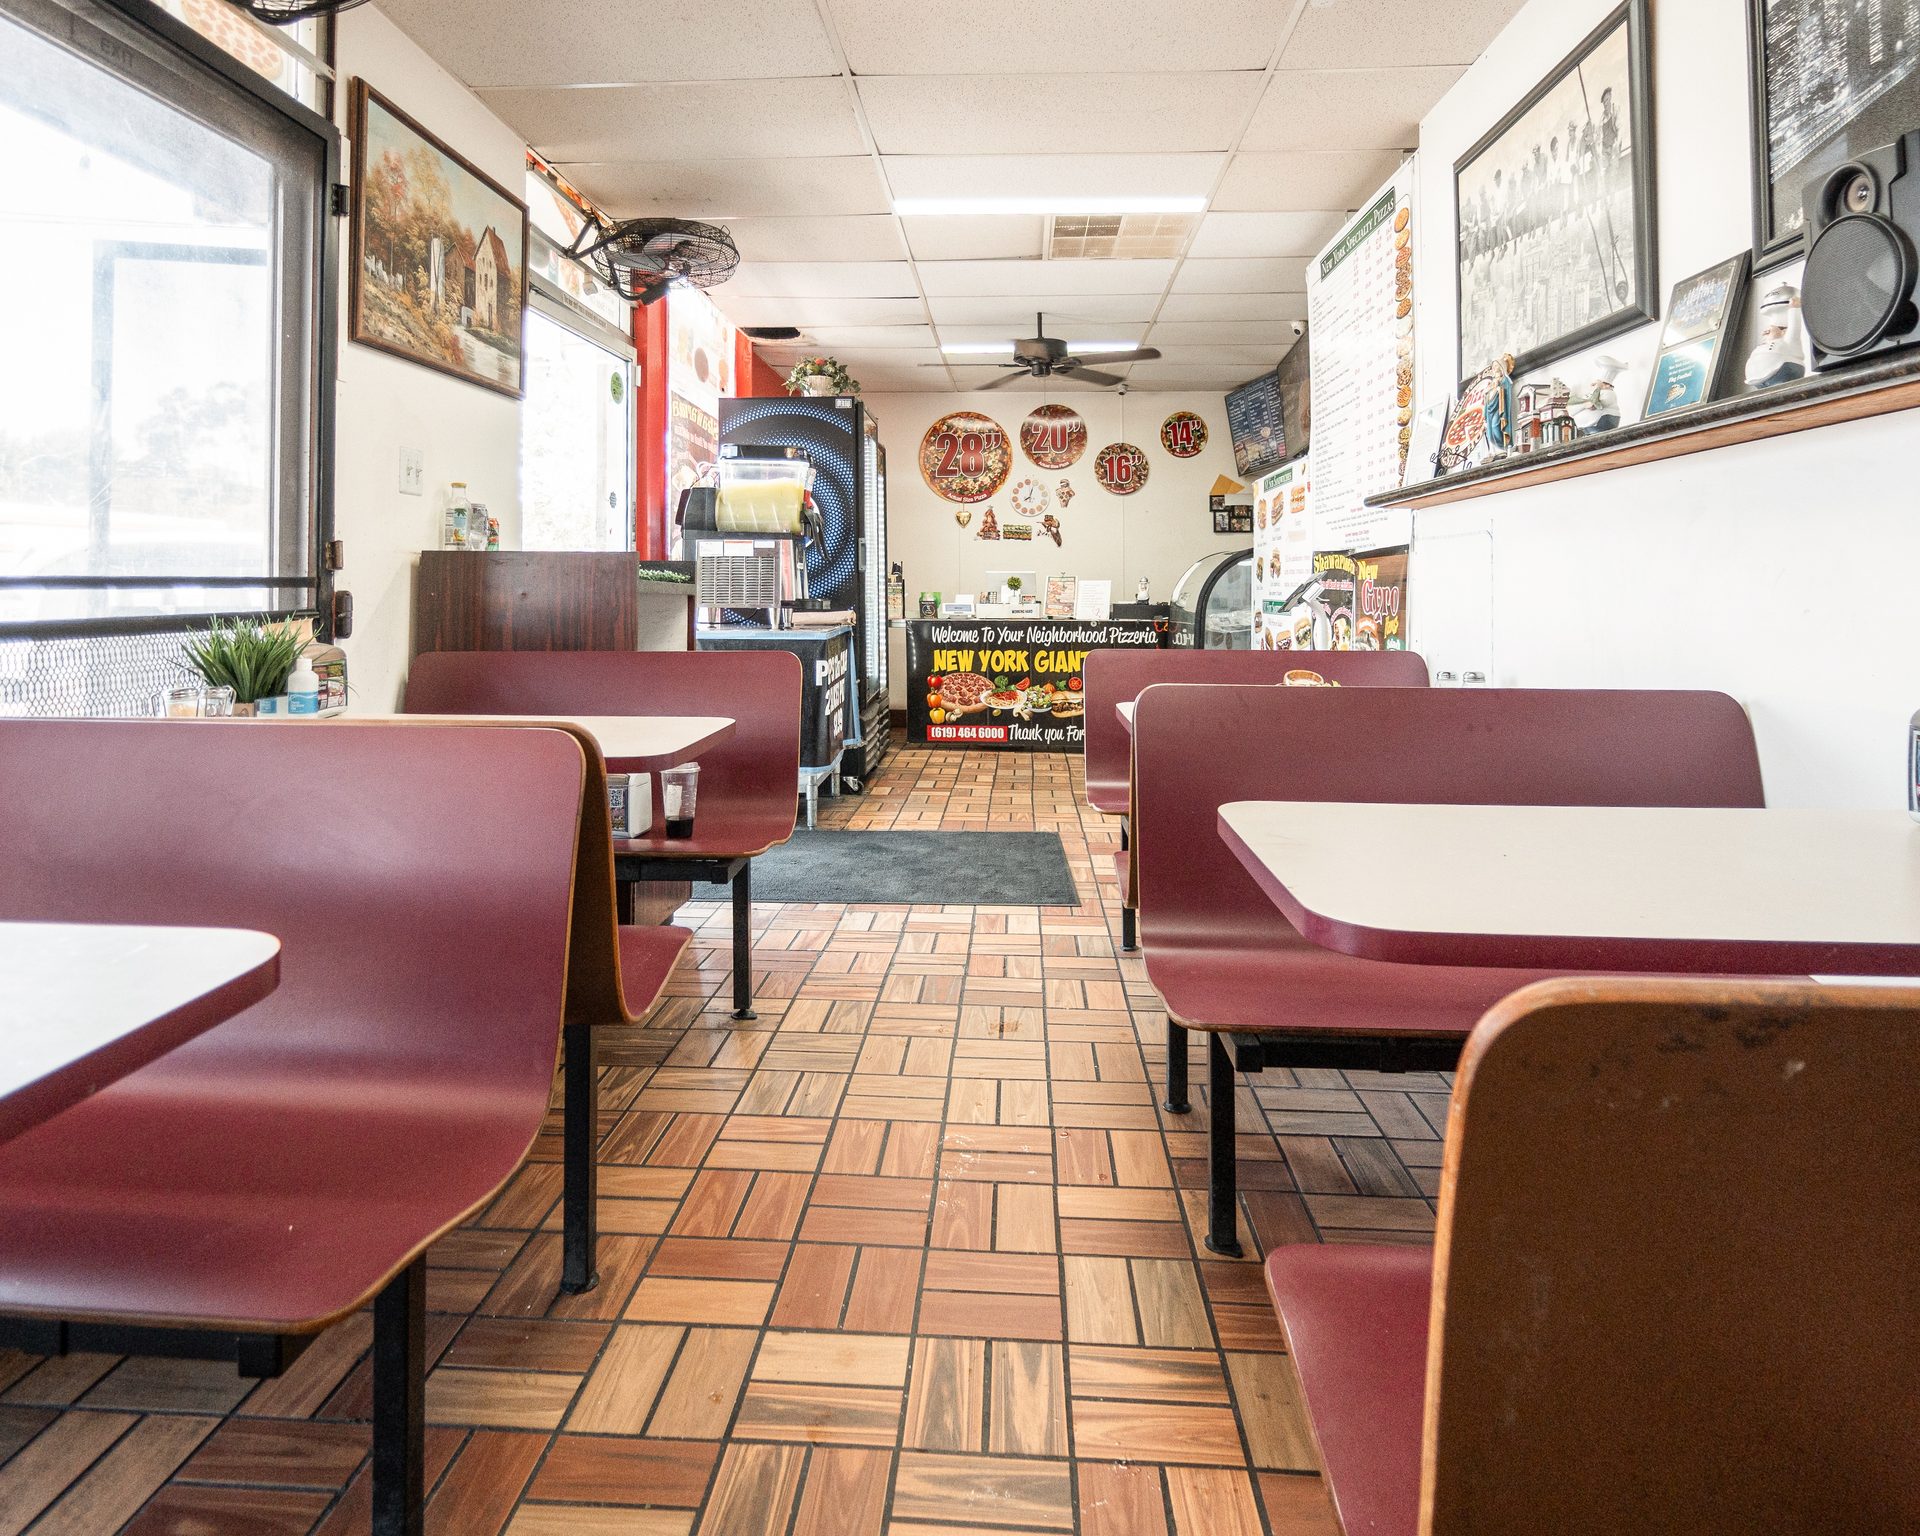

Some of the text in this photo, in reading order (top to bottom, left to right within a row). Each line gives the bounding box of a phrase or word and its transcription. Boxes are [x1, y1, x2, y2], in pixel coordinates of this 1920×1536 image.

[947, 493, 962, 502] Actual
[974, 493, 987, 502] Pizza
[1357, 560, 1379, 580] New
[1362, 580, 1400, 625] Gyro
[931, 625, 980, 644] Welcome
[981, 626, 995, 643] To
[997, 626, 1025, 645] Your
[1026, 625, 1107, 647] Neighborhood
[1109, 626, 1159, 644] Pizzeria
[933, 649, 975, 673] NEW
[978, 649, 1030, 673] YORK
[931, 726, 1005, 739] (619) 464 6000
[1008, 723, 1085, 744] Thank you For
